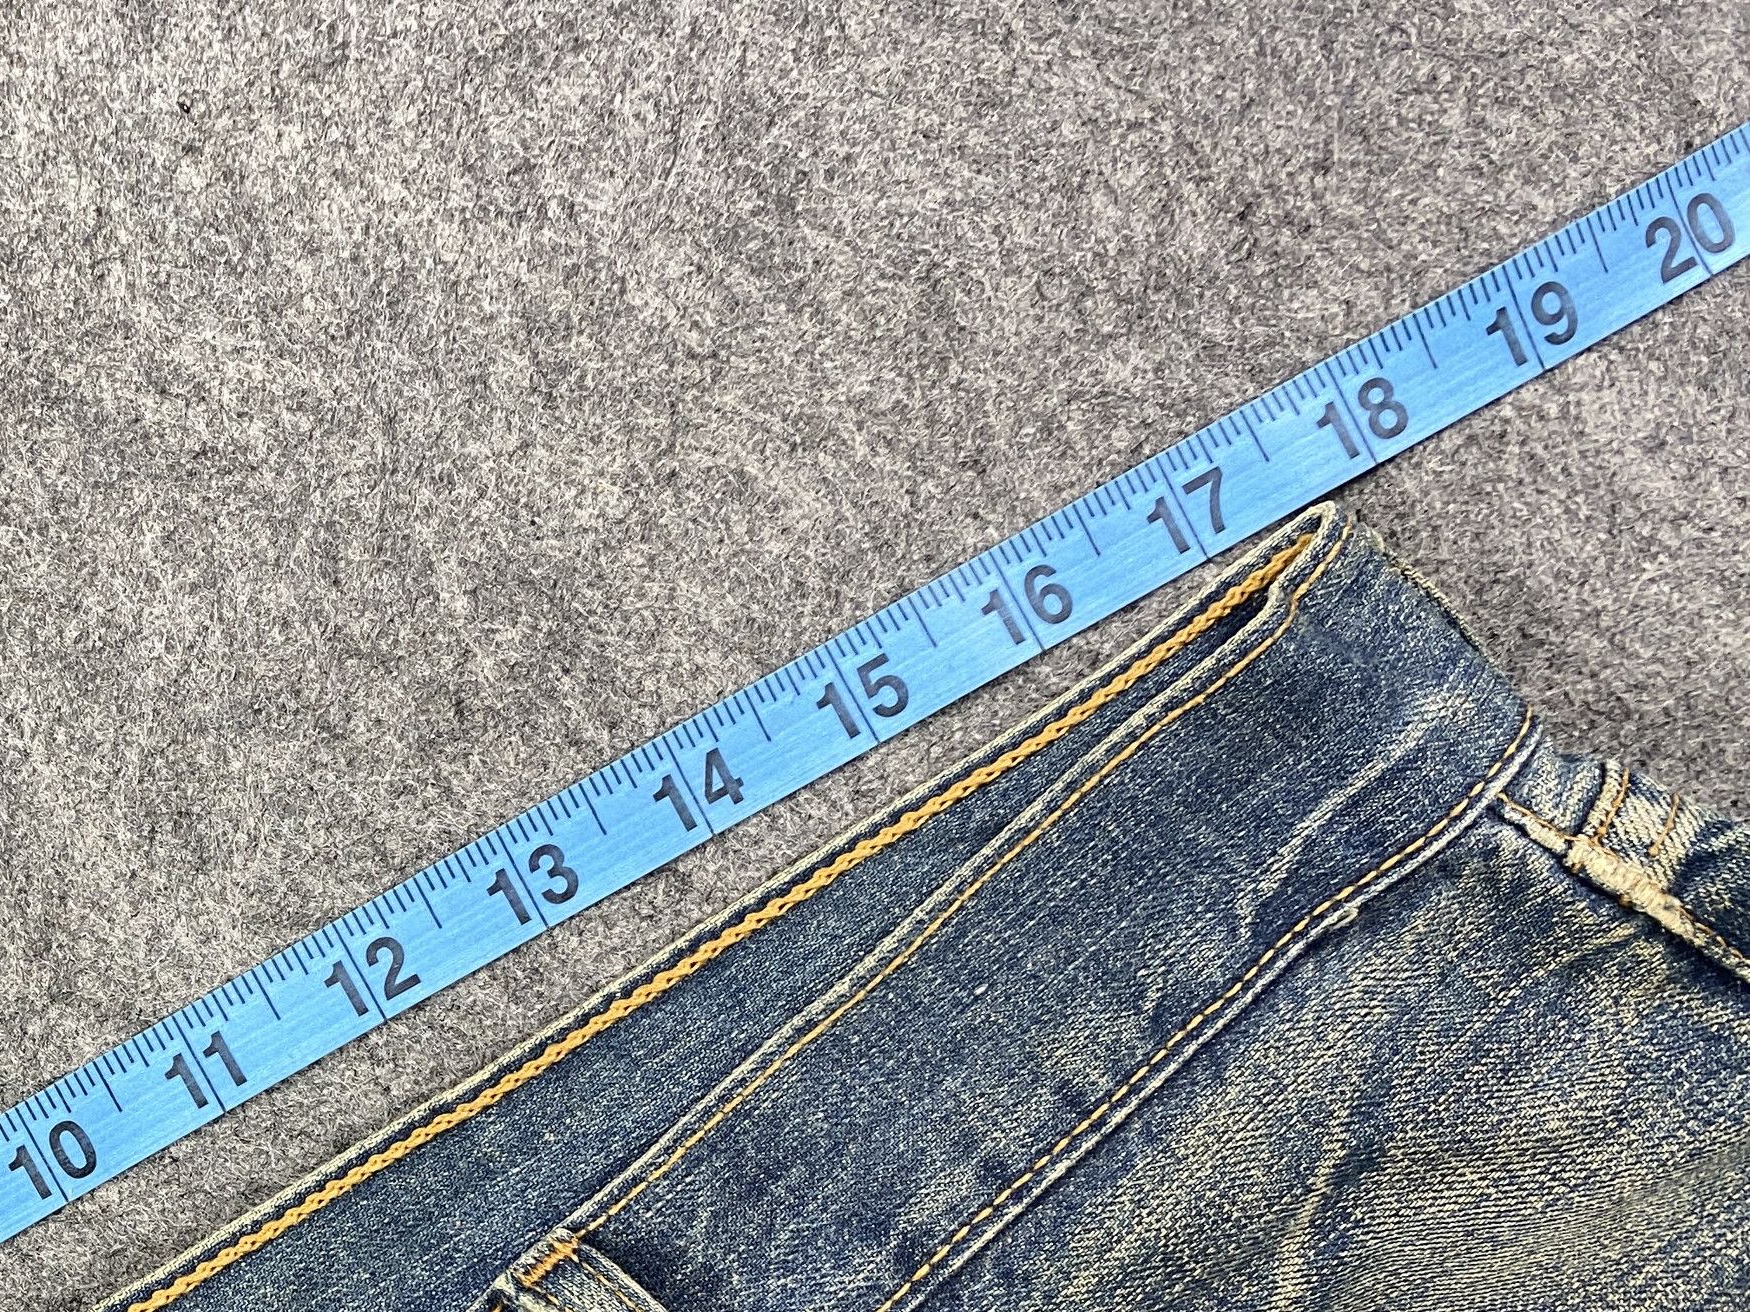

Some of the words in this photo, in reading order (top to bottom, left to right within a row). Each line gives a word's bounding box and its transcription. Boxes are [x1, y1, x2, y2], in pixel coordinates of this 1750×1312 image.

[1645, 192, 1735, 283] 20
[1487, 281, 1578, 366] 19
[1316, 377, 1408, 459] 18
[1147, 466, 1228, 554] 17
[982, 564, 1075, 646] 16
[816, 653, 909, 740] 15
[652, 747, 744, 832] 14
[486, 844, 579, 926] 13
[324, 936, 420, 1016] 12
[164, 1030, 248, 1110] 11
[8, 1120, 96, 1200] 10
